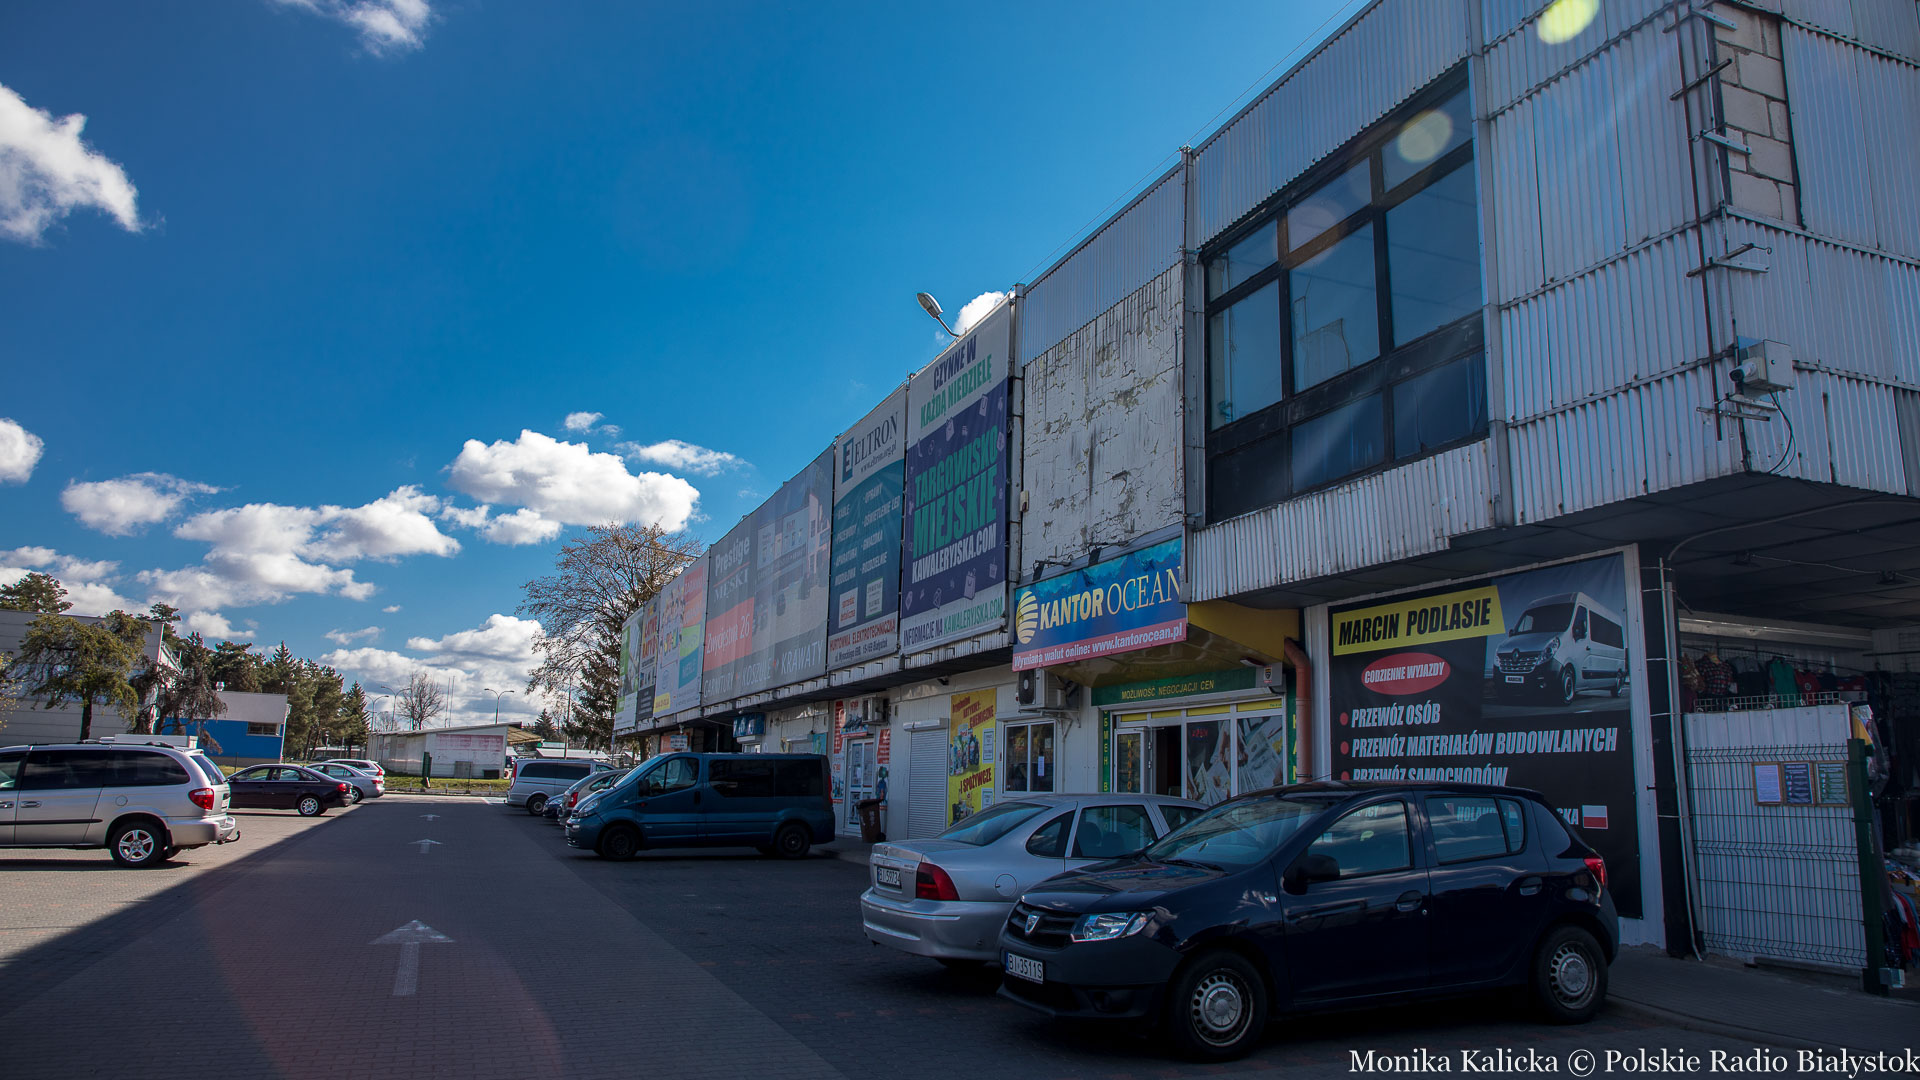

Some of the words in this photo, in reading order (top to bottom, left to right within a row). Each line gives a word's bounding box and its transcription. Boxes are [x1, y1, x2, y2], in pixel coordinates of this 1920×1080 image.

[933, 345, 966, 391] CZYNNE
[966, 335, 977, 365] W
[920, 389, 947, 429] KAŻDĄ
[948, 353, 992, 409] NIEDZIELĘ
[855, 411, 898, 465] ELTRON
[915, 424, 999, 507] TARGOWISKO
[913, 463, 997, 559] MIEJSKIE
[715, 536, 750, 576] Prestige
[912, 522, 997, 584] KAWALERYJSKA.COM
[903, 621, 935, 647] INFORMACJE
[935, 618, 943, 637] NA
[944, 596, 1003, 635] KAWALERYJSKA.COM
[1040, 588, 1104, 631] KANTOR
[1107, 566, 1181, 615] OCEAN
[1338, 613, 1400, 646] MARCIN
[1406, 598, 1491, 636] PODLASIE
[740, 614, 750, 639] 26
[1014, 653, 1043, 669] Wymiana
[1044, 649, 1064, 662] walut
[1065, 643, 1091, 658] online:
[1092, 622, 1183, 652] www.kantorocean.pl
[704, 672, 734, 698] GARNITURY
[781, 640, 824, 675] KRAWATY
[1158, 682, 1198, 696] NEGOCJACJI
[1200, 680, 1215, 691] CEN
[1364, 666, 1406, 684] CODZIENNE
[1406, 661, 1445, 679] WYJAZDY
[1351, 702, 1405, 728] PRZEWÓZ
[1405, 700, 1441, 725] OSÓB
[1352, 733, 1405, 758] PRZEWÓZ
[1406, 730, 1494, 757] MATERIAŁÓW
[1495, 727, 1618, 754] BUDOWLANYCH
[1009, 954, 1017, 971] BI
[1019, 958, 1043, 979] 3511S
